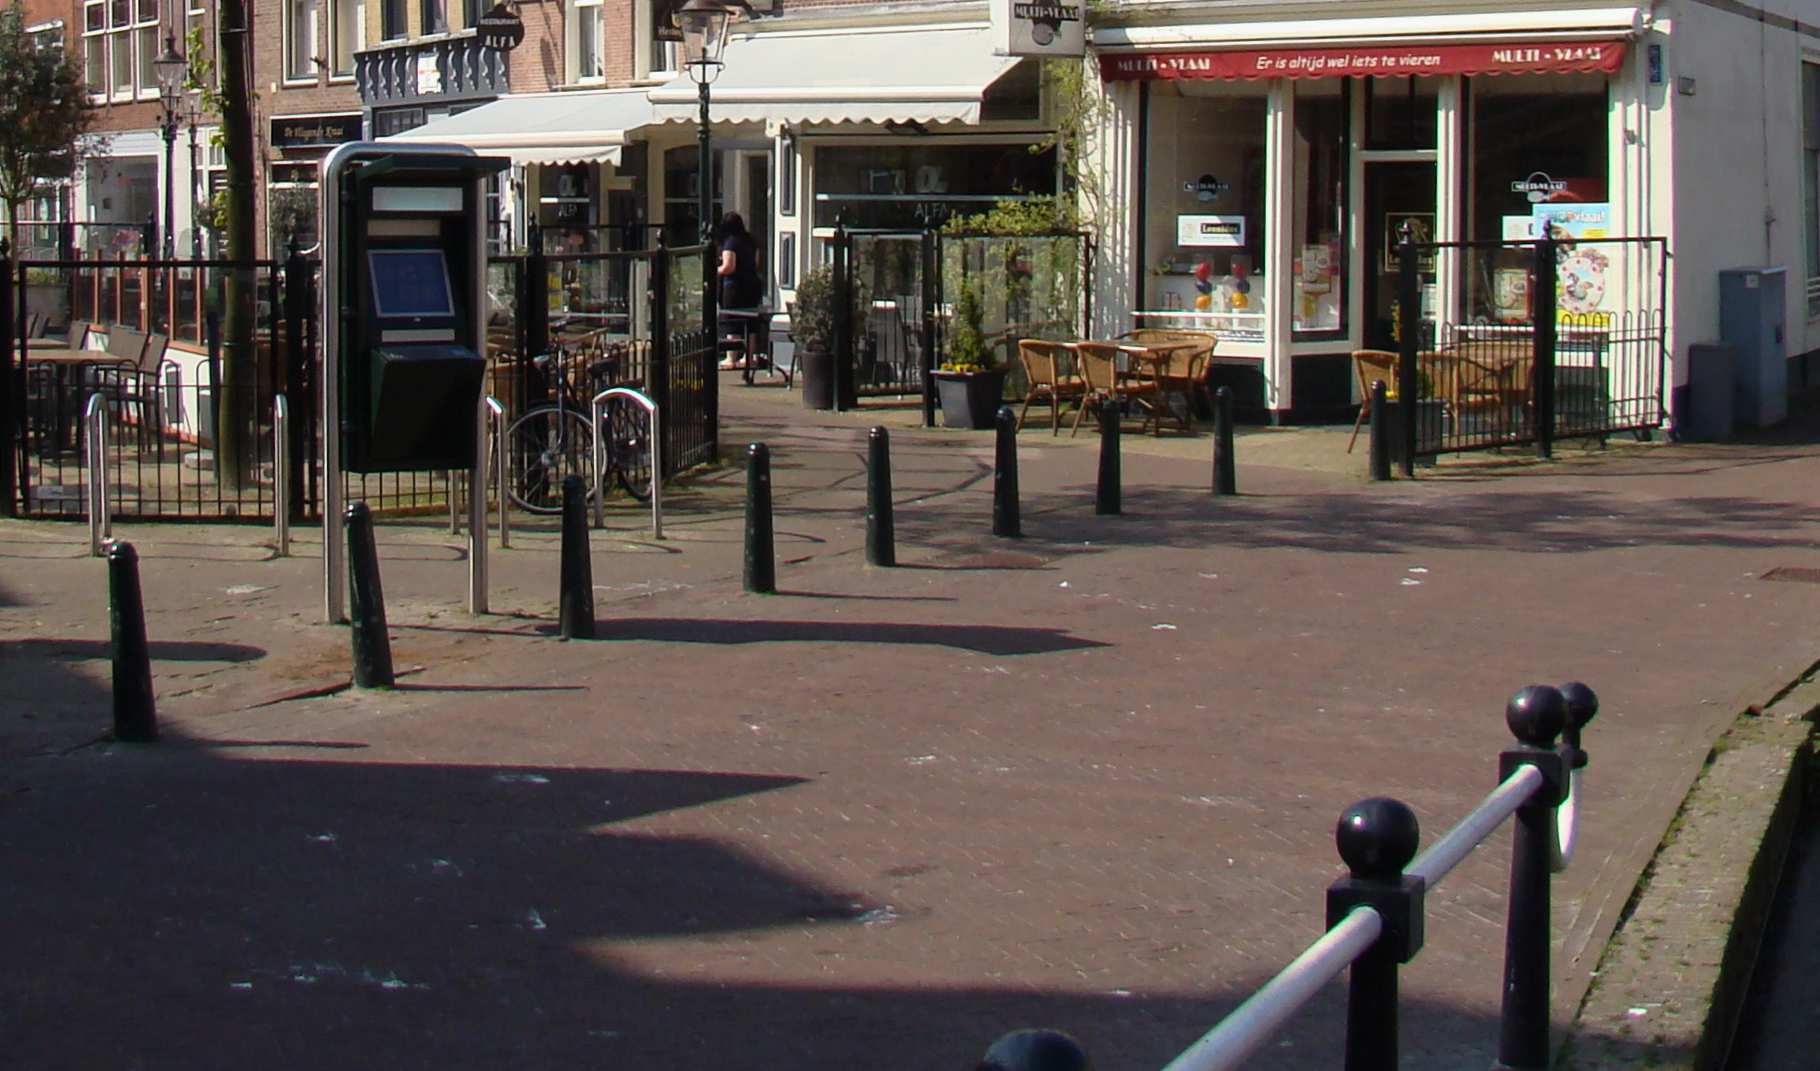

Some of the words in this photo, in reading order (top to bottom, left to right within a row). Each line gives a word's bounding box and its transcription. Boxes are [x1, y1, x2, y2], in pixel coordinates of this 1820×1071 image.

[479, 17, 520, 25] RESTAURANT
[485, 34, 516, 48] ALFA
[1256, 56, 1272, 70] Er
[1275, 55, 1286, 69] is
[1289, 54, 1324, 72] altijd
[1327, 54, 1348, 68] wel
[1352, 53, 1378, 67] iets
[1381, 54, 1394, 66] te
[1399, 52, 1441, 67] vieren
